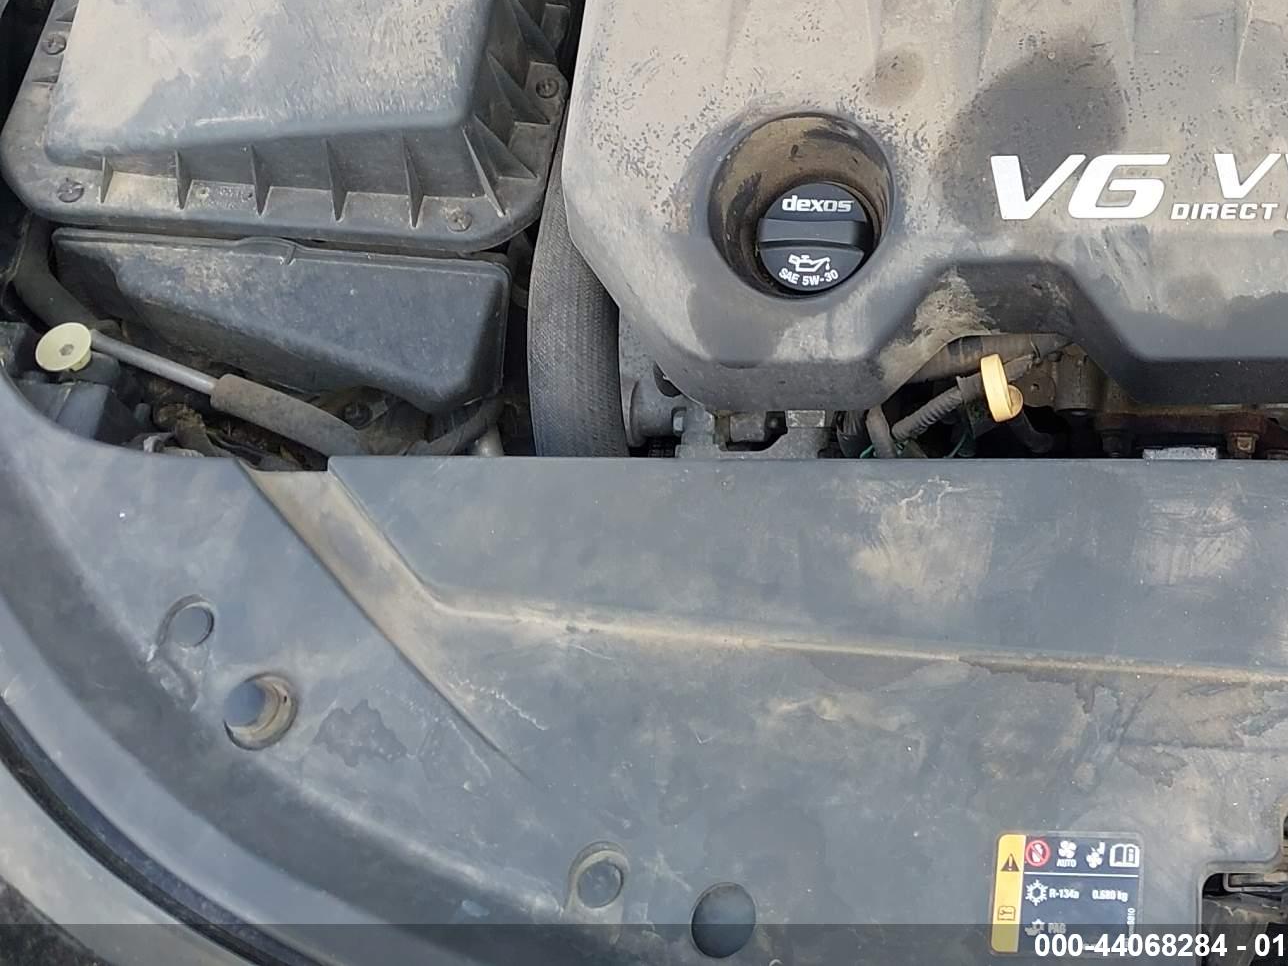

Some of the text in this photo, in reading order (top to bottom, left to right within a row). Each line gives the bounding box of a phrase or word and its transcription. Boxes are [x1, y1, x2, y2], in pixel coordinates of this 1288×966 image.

[990, 154, 1171, 220] V6
[782, 195, 854, 213] dexos
[1170, 202, 1278, 221] DIRECT
[778, 267, 839, 286] SAE 5W-30
[1056, 858, 1078, 868] AUTO
[1048, 889, 1080, 900] R-134a
